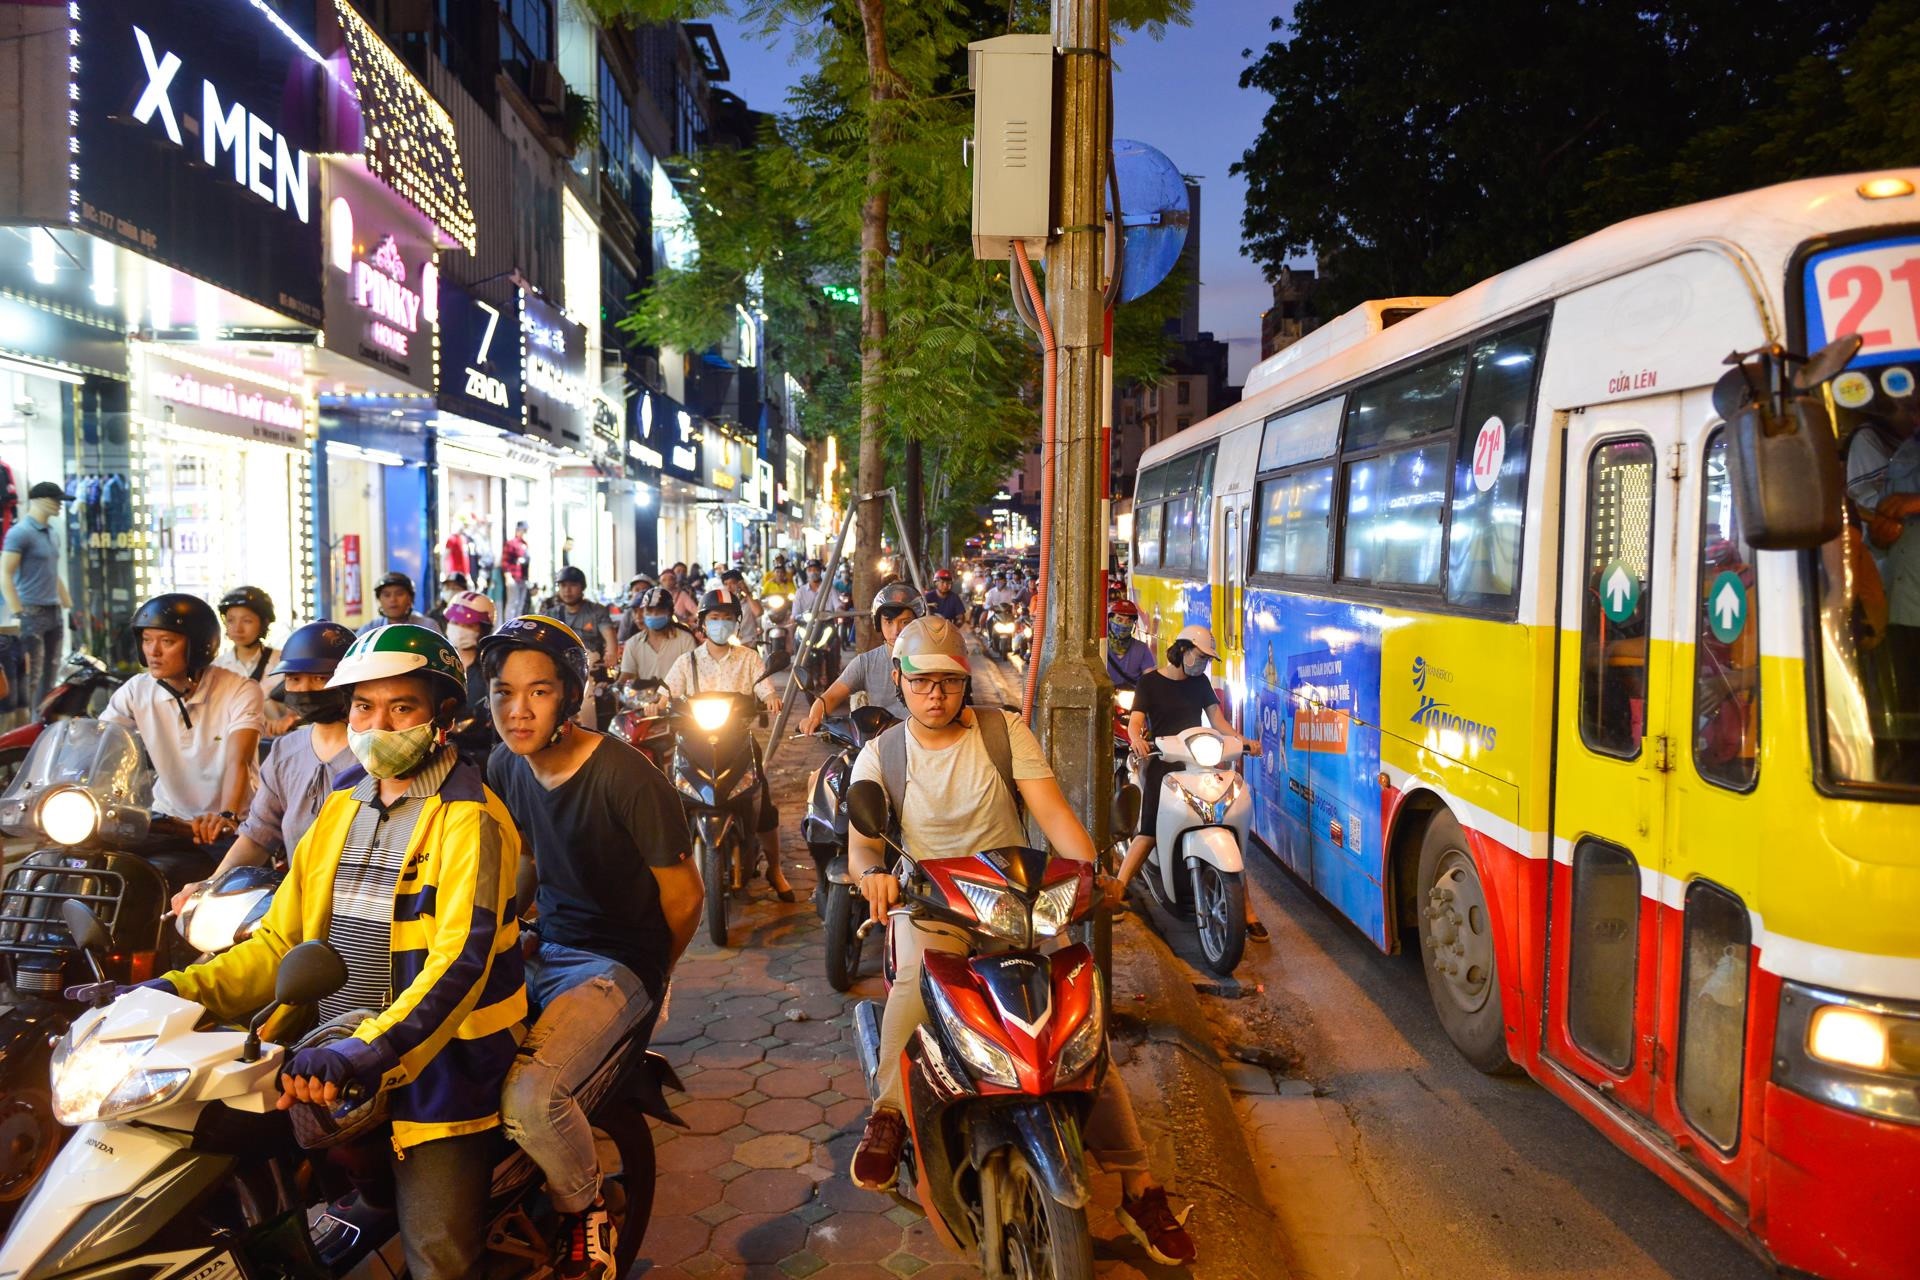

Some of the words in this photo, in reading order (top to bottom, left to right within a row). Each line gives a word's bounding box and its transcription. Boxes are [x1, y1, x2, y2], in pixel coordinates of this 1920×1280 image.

[356, 260, 420, 333] PINKY
[372, 321, 408, 356] HOUSE
[475, 299, 499, 365] 7
[1634, 369, 1657, 389] LÊN
[418, 853, 430, 864] be
[1000, 959, 1036, 968] HONDA
